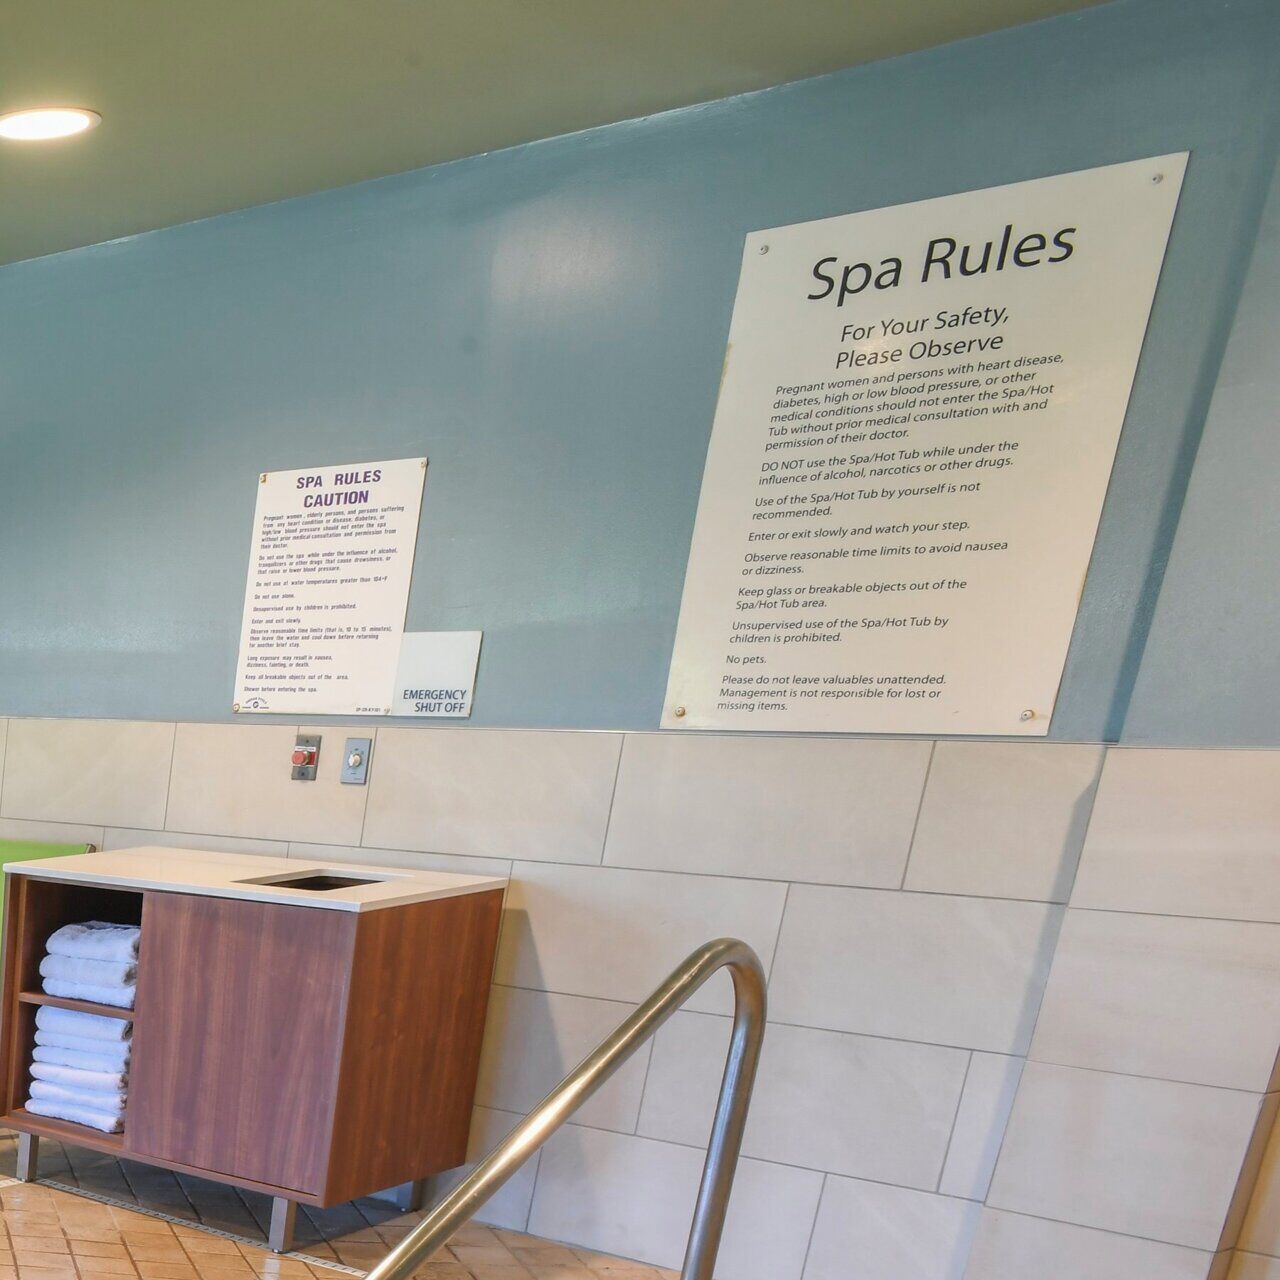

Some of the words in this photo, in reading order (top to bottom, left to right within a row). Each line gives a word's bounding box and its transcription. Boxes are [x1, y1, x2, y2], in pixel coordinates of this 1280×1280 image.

[807, 256, 902, 307] Spa
[921, 224, 1076, 282] Rules
[840, 324, 875, 342] For
[880, 317, 930, 336] Your
[933, 306, 1009, 330] Safety,
[835, 348, 902, 369] Please
[908, 335, 1003, 360] Observe
[775, 381, 825, 396] Pregnant
[827, 377, 869, 389] women
[871, 371, 895, 384] and
[896, 368, 944, 383] persons
[947, 362, 974, 375] with
[977, 359, 1011, 372] heart
[1013, 354, 1064, 367] disease,
[761, 461, 779, 472] DO
[780, 458, 805, 470] NOT
[806, 459, 825, 468] use
[828, 455, 846, 466] the
[848, 452, 896, 466] Spa/Hot
[898, 449, 920, 460] Tub
[922, 445, 955, 457] while
[957, 442, 995, 455] under
[998, 440, 1019, 451] the
[296, 475, 322, 488] SPA
[334, 469, 381, 485] RULES
[758, 474, 807, 485] influence
[809, 470, 823, 481] of
[823, 467, 866, 480] alcohol,
[869, 463, 921, 476] narcotics
[923, 463, 937, 472] or
[939, 459, 973, 471] other
[974, 456, 1013, 469] drugs.
[304, 490, 368, 507] CAUTION
[748, 531, 776, 541] Enter
[777, 532, 790, 540] or
[791, 528, 811, 539] exit
[813, 526, 848, 538] slowly
[849, 524, 872, 535] and
[875, 522, 909, 534] watch
[911, 523, 939, 534] your
[941, 521, 969, 531] step.
[744, 552, 787, 562] Observe
[789, 548, 849, 560] reasonable
[852, 547, 877, 557] time
[879, 545, 911, 555] limits
[914, 546, 926, 554] to
[928, 541, 962, 553] avoid
[964, 542, 1008, 551] nausea
[754, 565, 804, 575] dizziness.
[732, 619, 803, 632] Unsupervised
[825, 618, 839, 628] of
[840, 618, 858, 628] the
[860, 617, 907, 629] Spa/Hot
[909, 616, 931, 626] Tub
[933, 616, 949, 628] by
[729, 633, 770, 643] children
[773, 633, 781, 642] is
[782, 631, 842, 644] prohibited.
[725, 654, 740, 663] No
[741, 655, 766, 665] pets.
[721, 674, 753, 684] Please
[755, 675, 769, 684] do
[771, 676, 790, 684] not
[791, 674, 820, 684] leave
[822, 674, 874, 684] valuables
[876, 674, 946, 684] unattended.
[403, 689, 467, 700] EMERGENCY
[414, 701, 443, 713] SHUT
[444, 701, 465, 713] OFF
